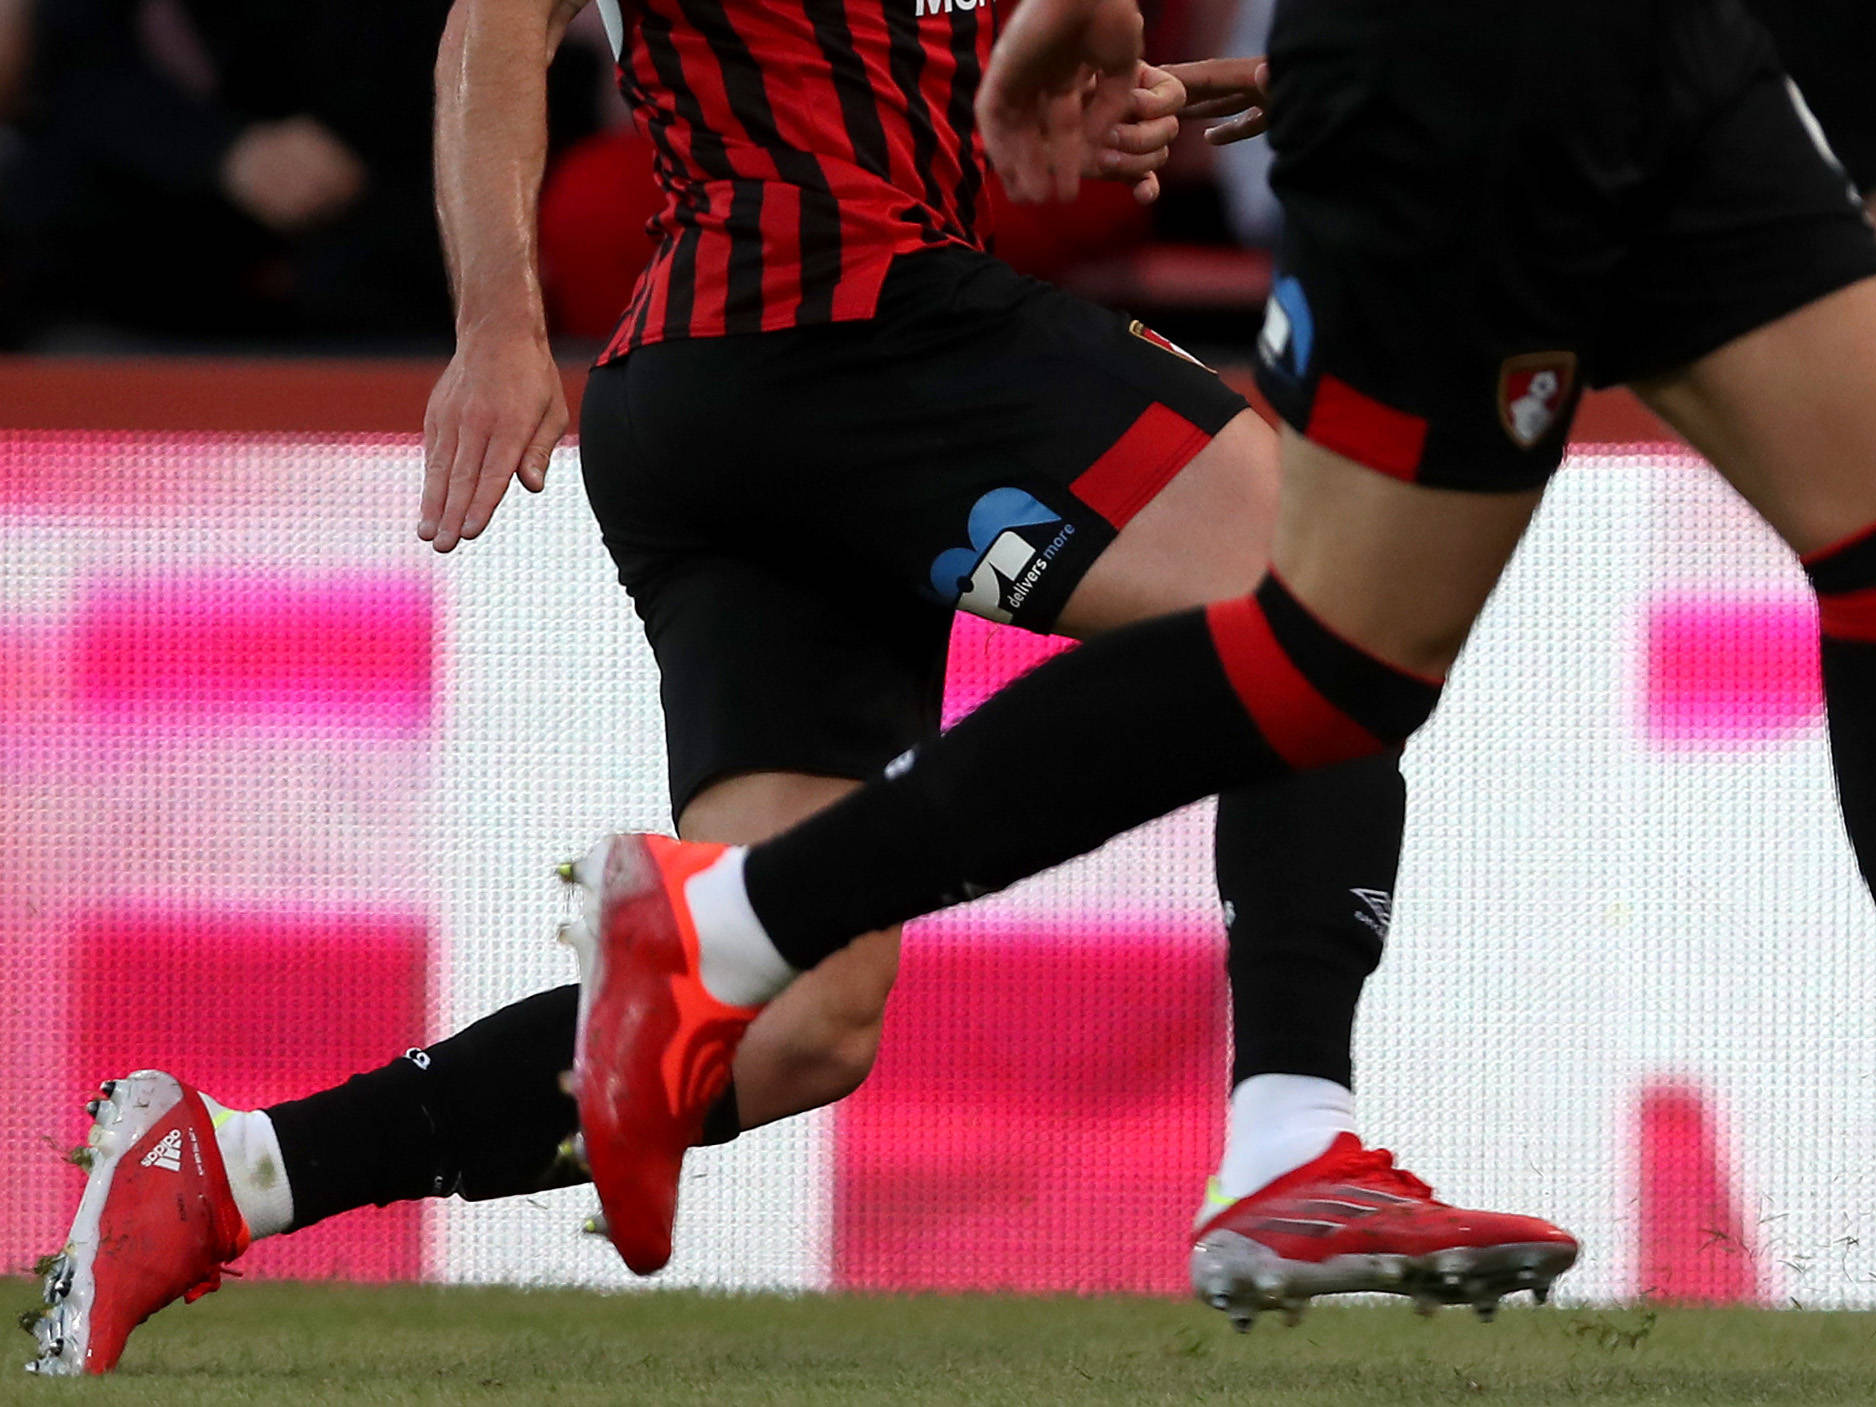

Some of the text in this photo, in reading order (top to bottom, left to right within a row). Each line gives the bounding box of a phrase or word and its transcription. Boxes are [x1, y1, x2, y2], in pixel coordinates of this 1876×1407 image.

[1007, 523, 1076, 609] delivers more
[140, 1129, 181, 1167] adidas
